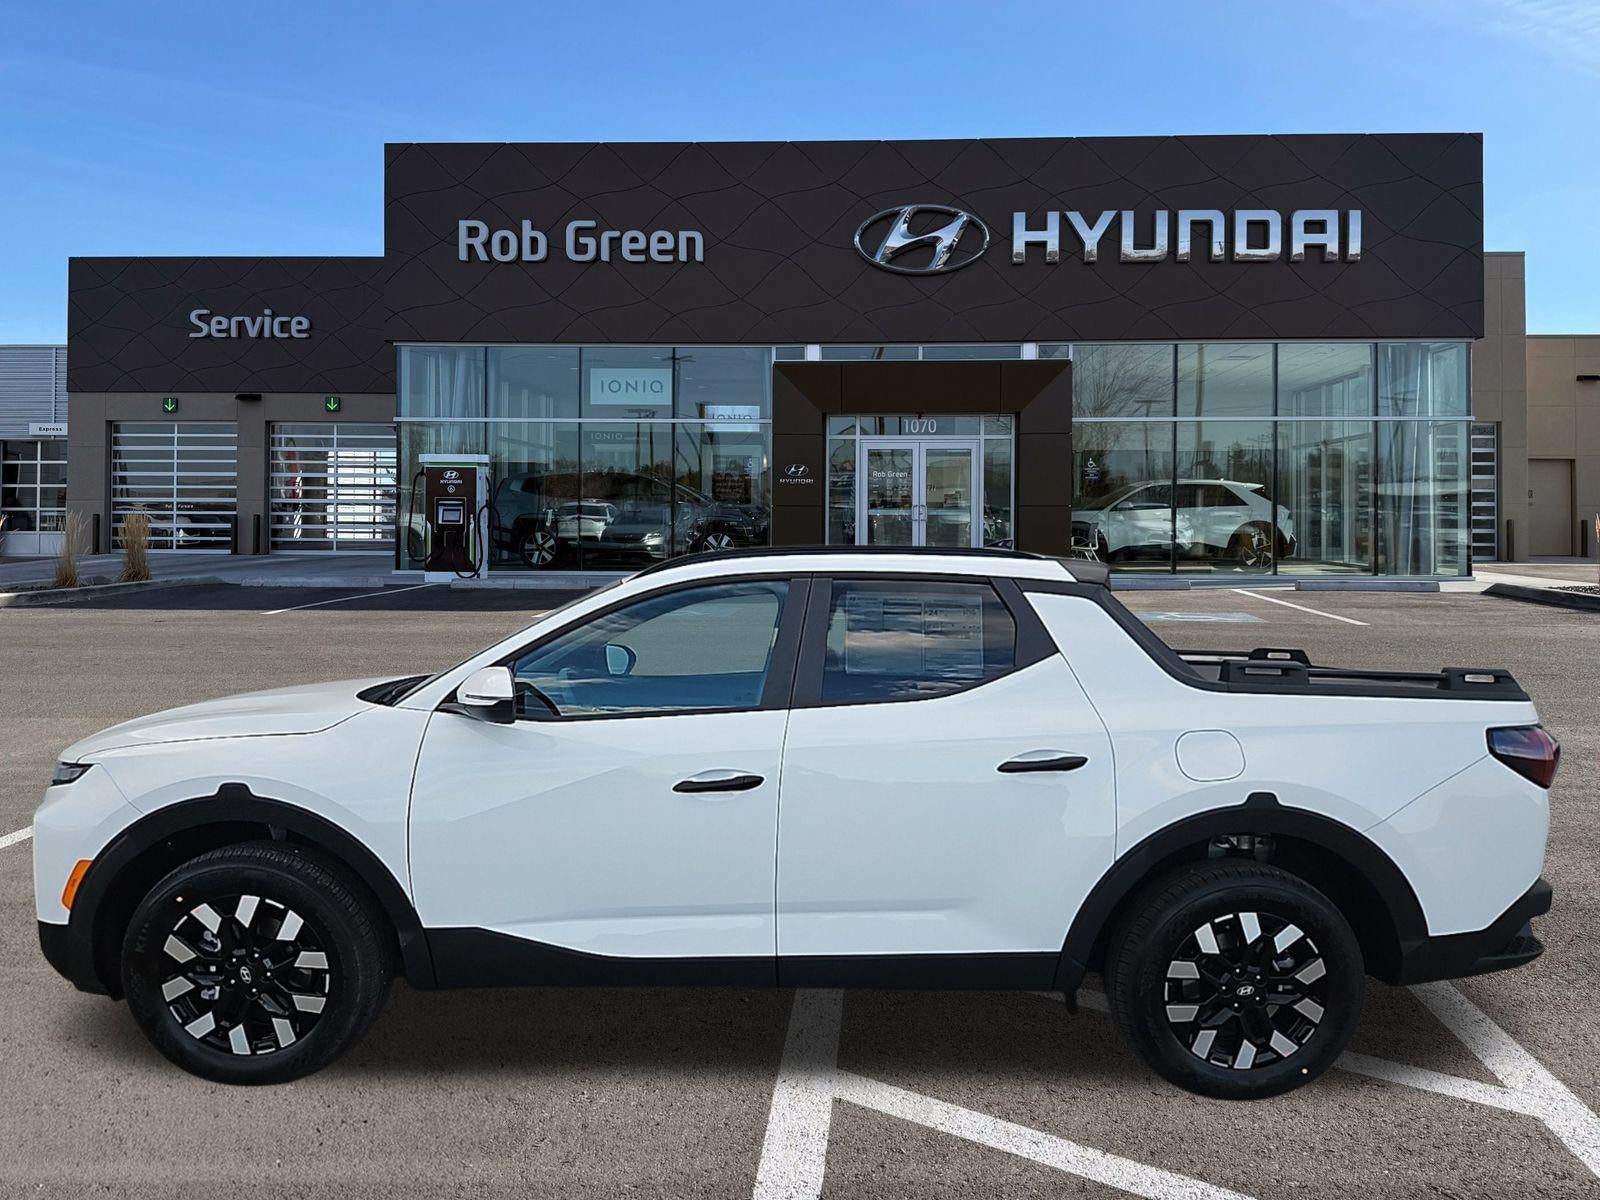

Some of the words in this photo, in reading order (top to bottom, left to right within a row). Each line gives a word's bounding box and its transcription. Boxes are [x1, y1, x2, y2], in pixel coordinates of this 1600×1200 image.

[458, 219, 548, 263] Rob
[565, 219, 705, 263] Green
[1012, 209, 1362, 264] HYUNDAI
[189, 308, 311, 338] Service
[600, 379, 664, 394] IONIQ
[903, 419, 938, 433] 1070
[591, 432, 624, 440] IONIQ
[872, 470, 886, 478] Rob
[887, 470, 908, 478] Green
